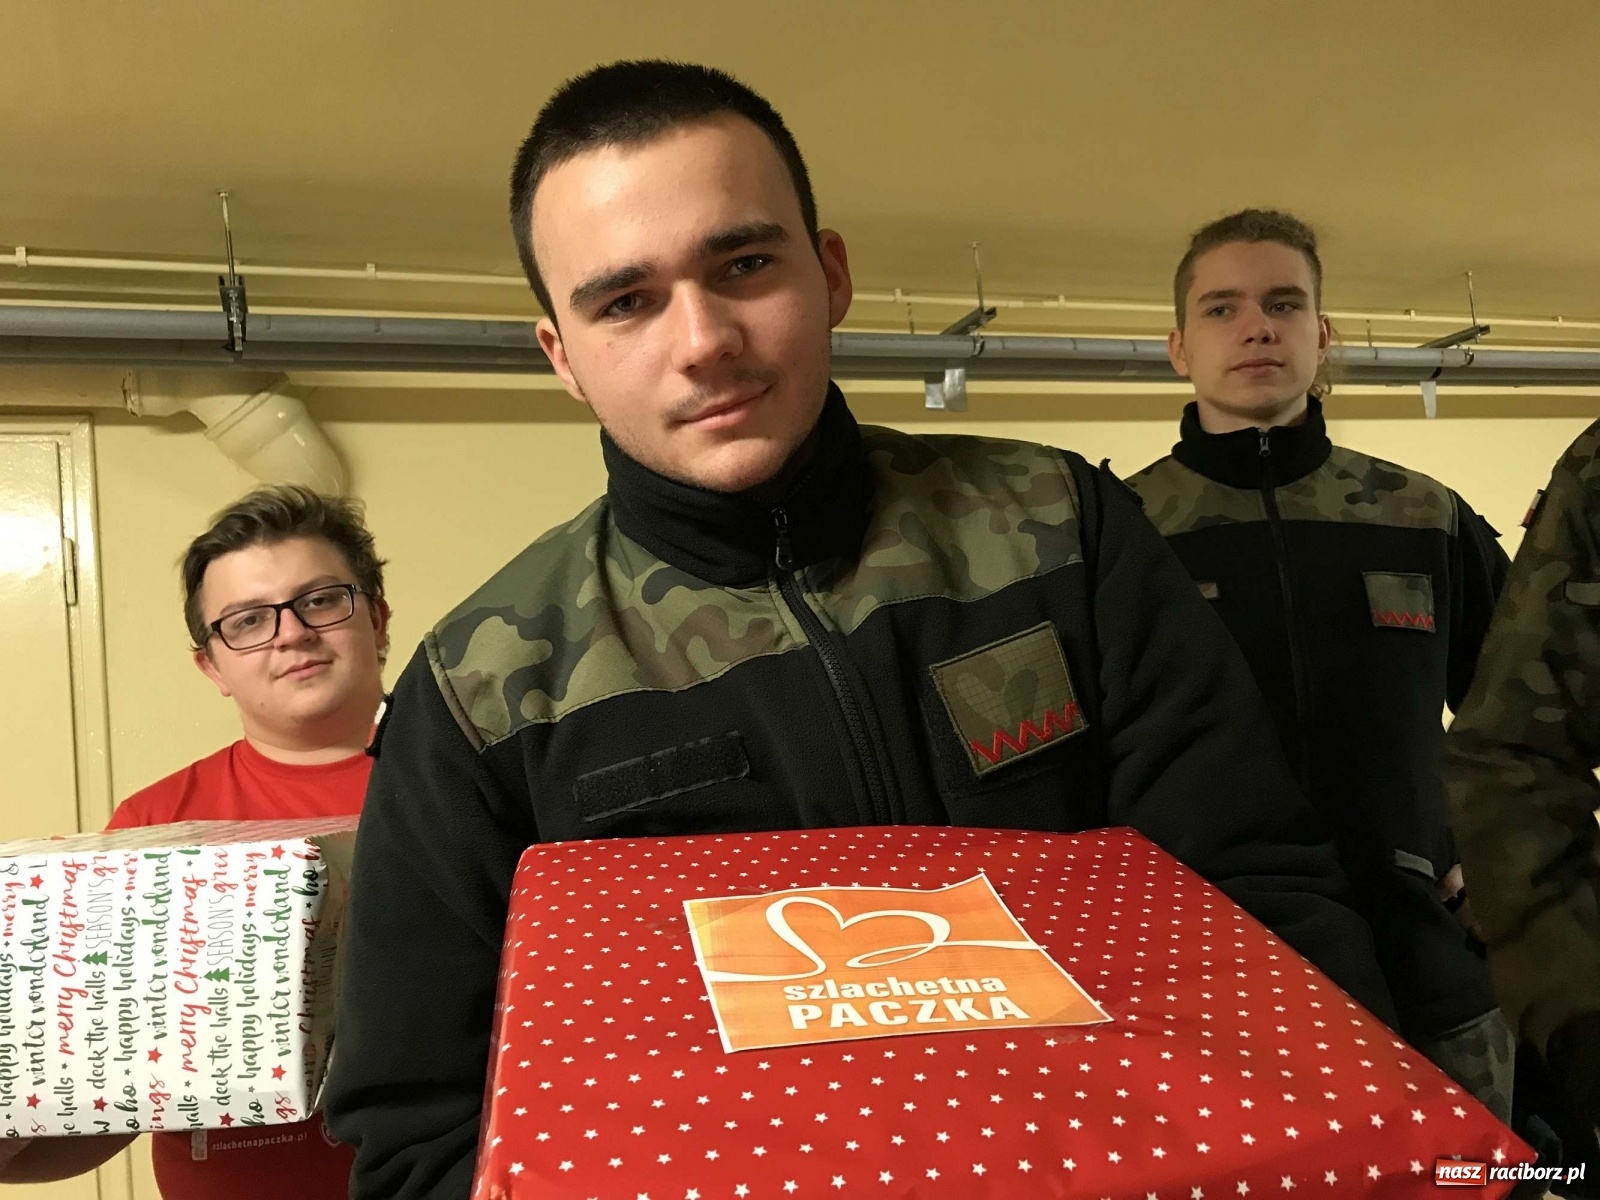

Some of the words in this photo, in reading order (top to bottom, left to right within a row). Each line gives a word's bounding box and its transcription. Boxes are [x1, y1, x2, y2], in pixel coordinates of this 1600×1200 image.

[1, 882, 26, 937] merry
[141, 850, 173, 967] wonderland
[243, 852, 268, 908] merry
[291, 866, 320, 897] ho
[52, 857, 88, 978] Christmas
[85, 878, 114, 949] SEASON'S
[173, 873, 208, 995] Christmas
[207, 894, 235, 966] SEASON'S
[262, 864, 292, 984] wonderland
[19, 893, 50, 1014] wonderland
[111, 906, 141, 991] holidays
[233, 923, 262, 1008] holidays
[84, 970, 109, 1011] halls
[142, 971, 168, 1040] winter
[207, 987, 232, 1028] halls
[783, 974, 1008, 1001] szlachetna
[787, 995, 1031, 1030] PACZKA
[22, 1018, 46, 1086] winter
[57, 987, 89, 1056] merry
[84, 1015, 109, 1049] the
[113, 997, 141, 1062] happy
[179, 1003, 213, 1073] merry
[207, 1032, 233, 1066] the
[237, 1014, 264, 1079] happy
[266, 988, 292, 1057] winter
[53, 1076, 78, 1117] halls
[86, 1045, 110, 1090] deck
[113, 1082, 139, 1113] ho
[210, 1062, 233, 1106] deck
[212, 1131, 308, 1151] szlachetnapaczka.pl
[240, 1098, 266, 1125] ho
